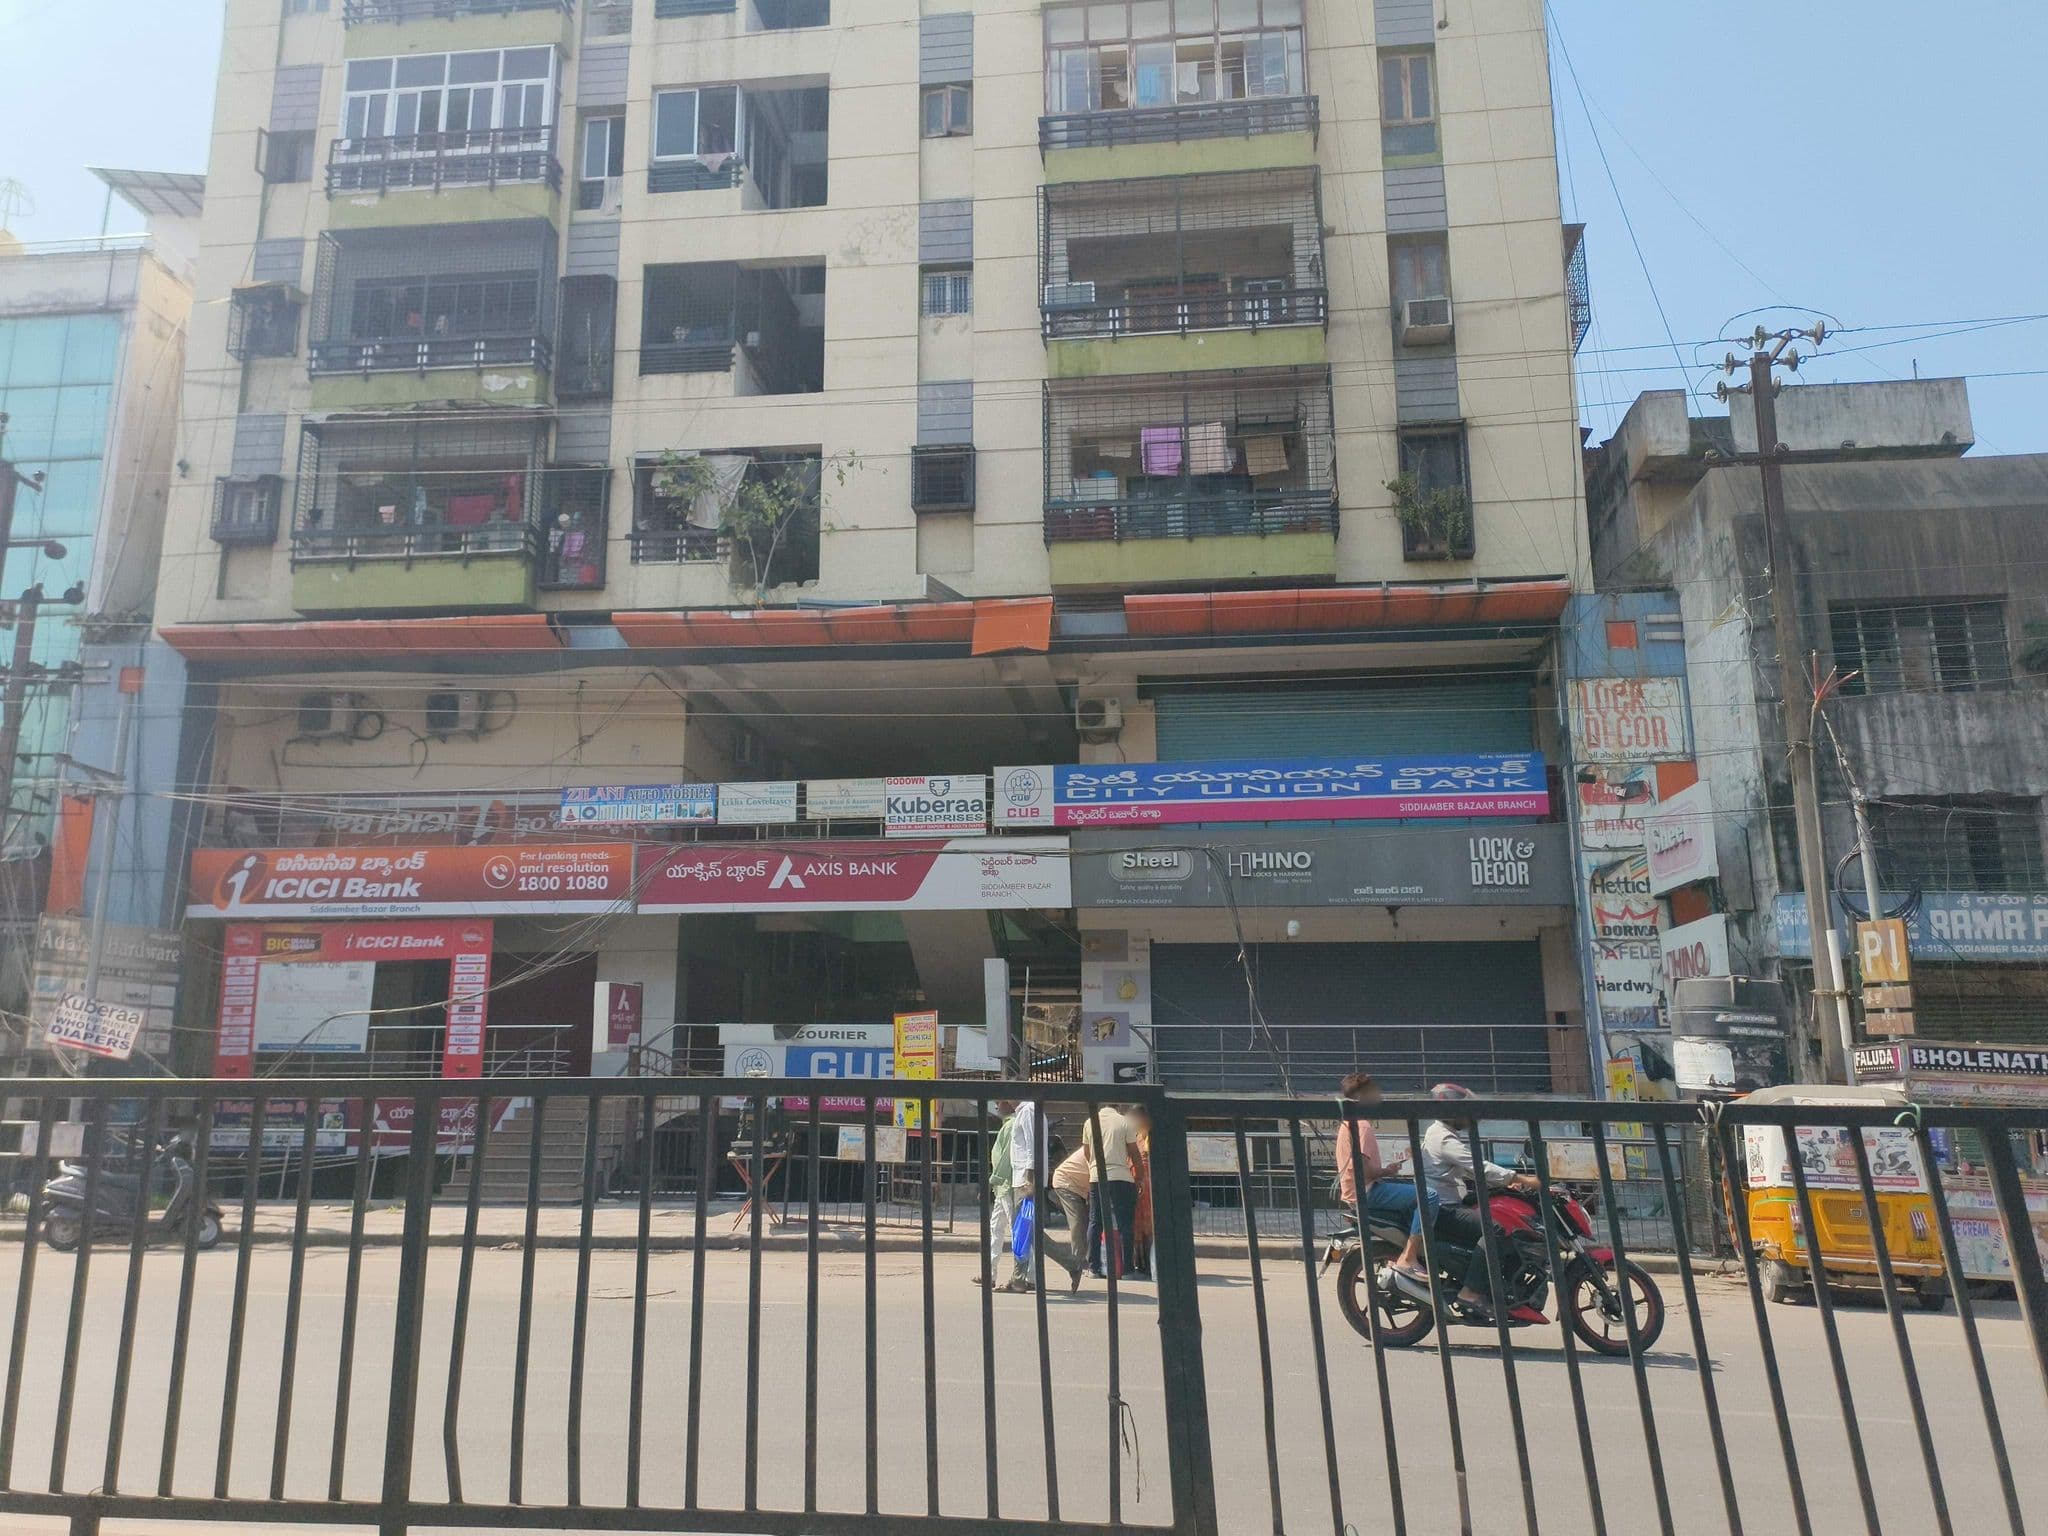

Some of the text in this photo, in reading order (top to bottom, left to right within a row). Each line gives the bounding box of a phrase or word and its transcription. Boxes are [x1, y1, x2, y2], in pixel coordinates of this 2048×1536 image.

[886, 777, 925, 786] GODOWN
[1066, 777, 1532, 799] CITY UNION BANK
[567, 786, 711, 801] ZILANI AUTO MOBILE
[887, 796, 984, 815] Kuberaa
[1007, 807, 1040, 818] CUB
[1399, 800, 1537, 812] SIDDIAMBER BAZAAR BRANCH
[888, 813, 983, 823] ENTERPRISES
[520, 851, 609, 863] For banking needs
[1469, 837, 1514, 861] LOCK
[520, 862, 609, 873] and resolution
[1122, 851, 1179, 869] Sheel
[1252, 851, 1312, 869] HINO
[804, 862, 897, 876] AXIS BANK
[1471, 861, 1530, 886] DECOR
[264, 876, 423, 899] ICICI Bank
[518, 875, 608, 891] 1800 1080
[361, 904, 387, 913] Bazar
[389, 904, 421, 913] Branch
[1602, 925, 1659, 937] DORMA
[1929, 909, 2026, 940] RAMA
[356, 935, 444, 949] ICICI Bank
[1949, 944, 2009, 953] DDIAMBER
[1862, 930, 1883, 977] P
[58, 992, 141, 1025] Kuberaa
[55, 1015, 132, 1039] WHOLESALE
[50, 1025, 130, 1051] DIAPERS
[1855, 1048, 1894, 1067] FALUDA
[876, 1097, 893, 1107] AN
[1962, 1221, 1991, 1238] CREAM
